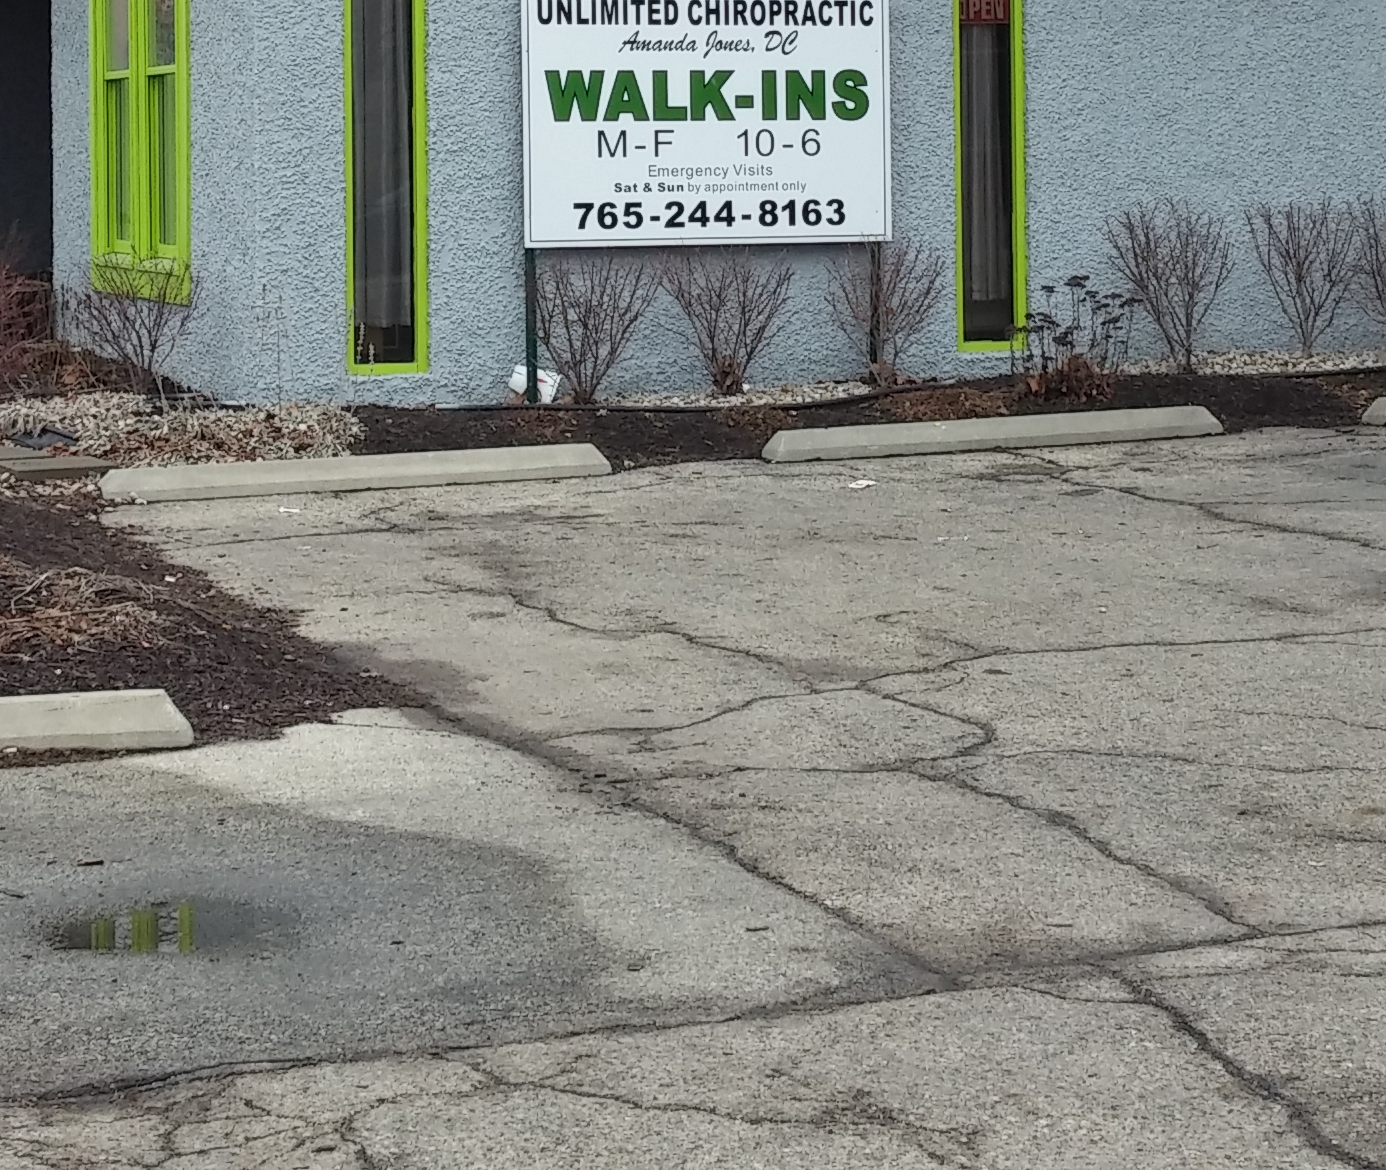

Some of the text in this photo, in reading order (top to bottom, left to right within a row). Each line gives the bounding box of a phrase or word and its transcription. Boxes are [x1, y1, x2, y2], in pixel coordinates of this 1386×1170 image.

[687, 0, 874, 27] CHIROPRACTIC
[618, 30, 799, 59] Amanda Jones, DC
[544, 69, 870, 122] WALK-INS
[648, 164, 773, 180] Emergency Visits
[614, 181, 807, 195] Sat & Sun by appointment only
[574, 198, 846, 230] 765-244-8163
